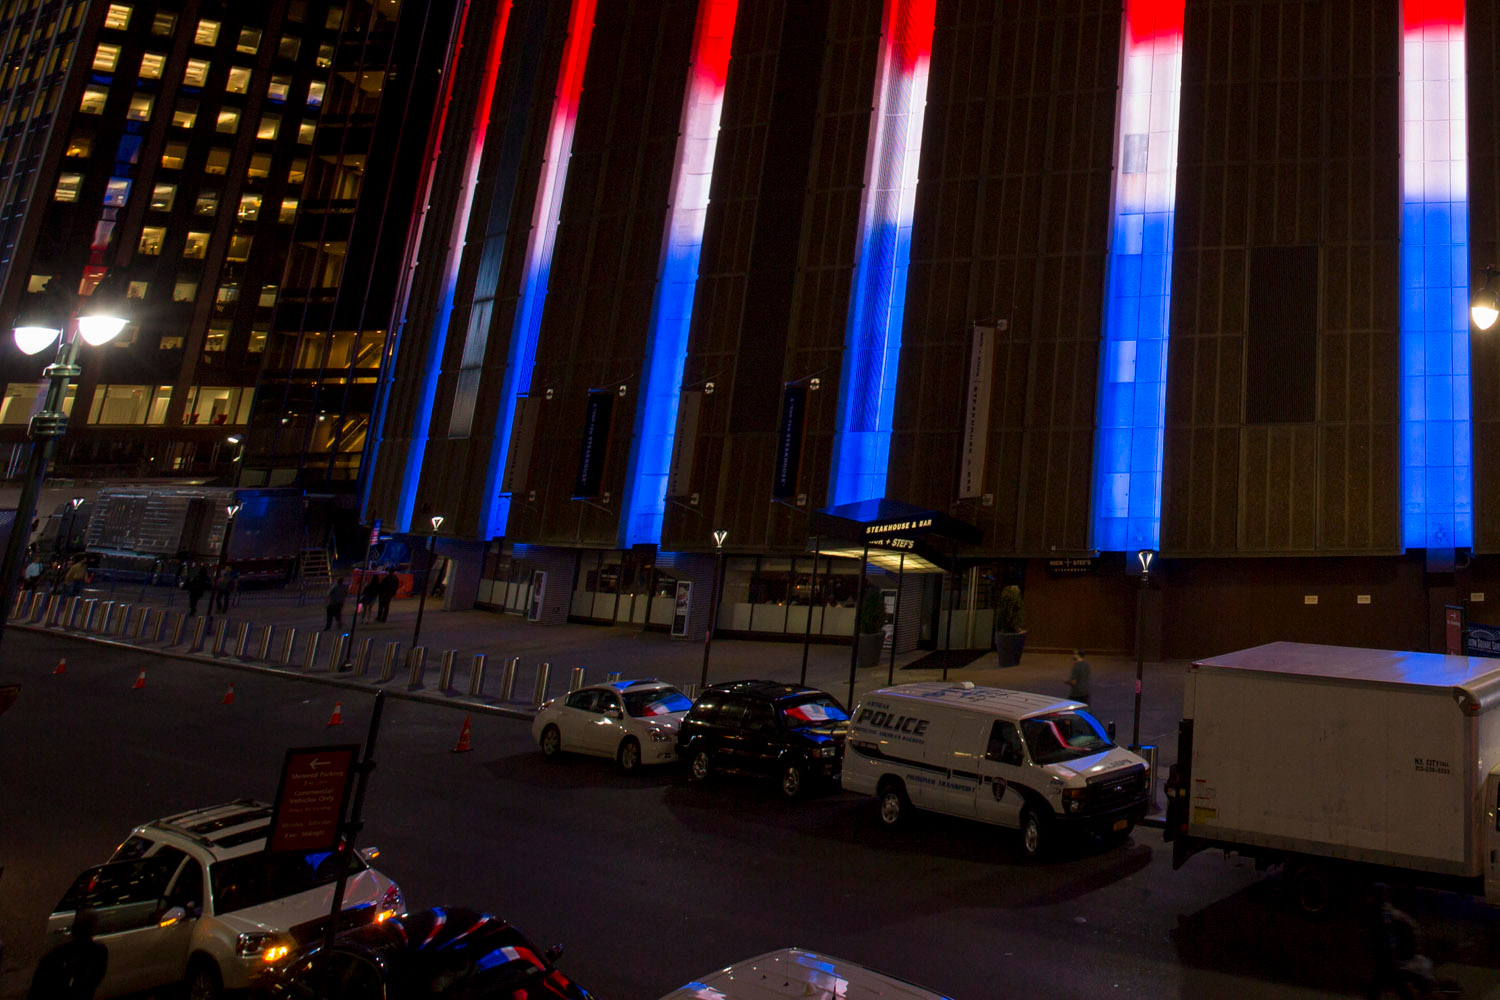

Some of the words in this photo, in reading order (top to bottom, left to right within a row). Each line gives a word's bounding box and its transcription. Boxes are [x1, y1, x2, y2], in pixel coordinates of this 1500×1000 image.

[866, 522, 910, 534] STEAKHOUSE
[911, 521, 917, 529] &
[918, 519, 933, 528] BAR
[857, 708, 930, 735] POLICE
